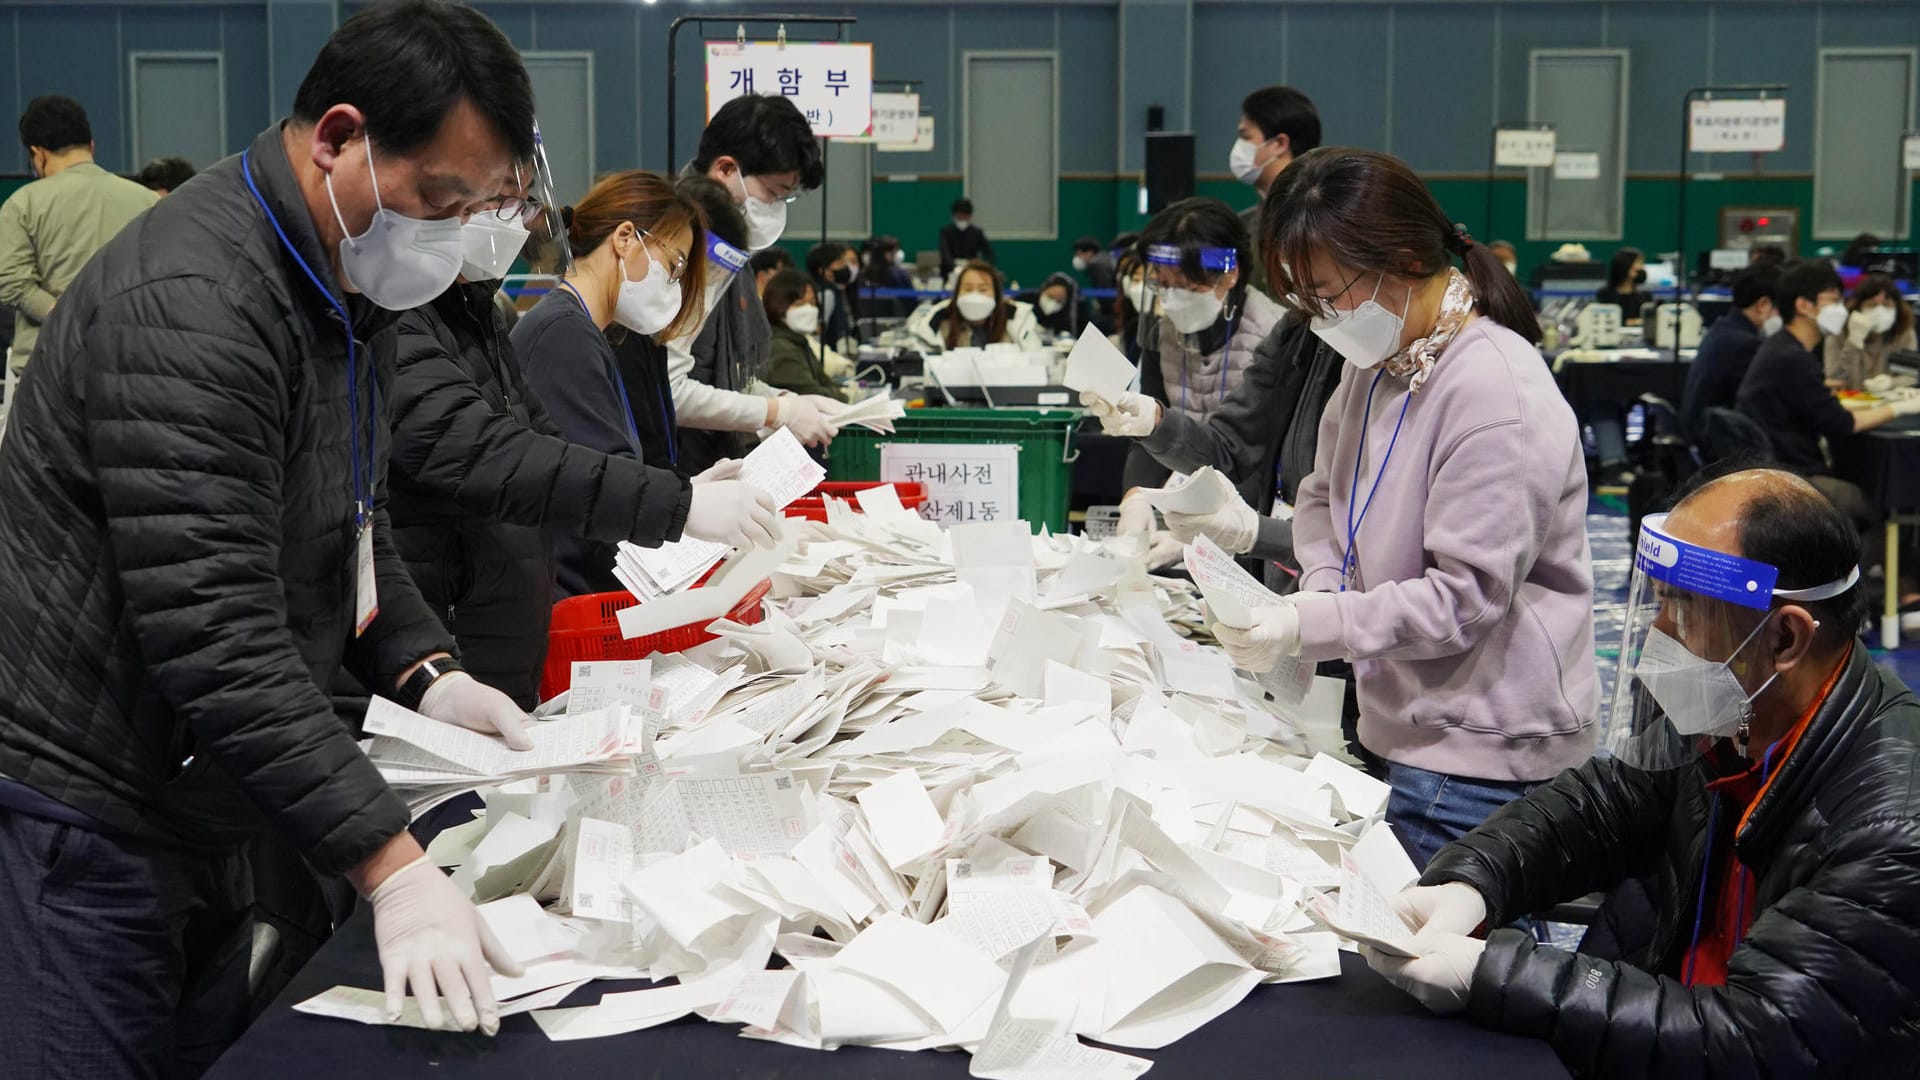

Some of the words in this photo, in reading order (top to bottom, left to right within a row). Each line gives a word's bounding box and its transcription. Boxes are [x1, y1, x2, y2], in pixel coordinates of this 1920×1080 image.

[730, 67, 754, 94] 개
[777, 68, 802, 95] 함
[824, 69, 850, 97] 부
[905, 462, 993, 485] 관내사전
[920, 500, 1000, 522] 산제1동
